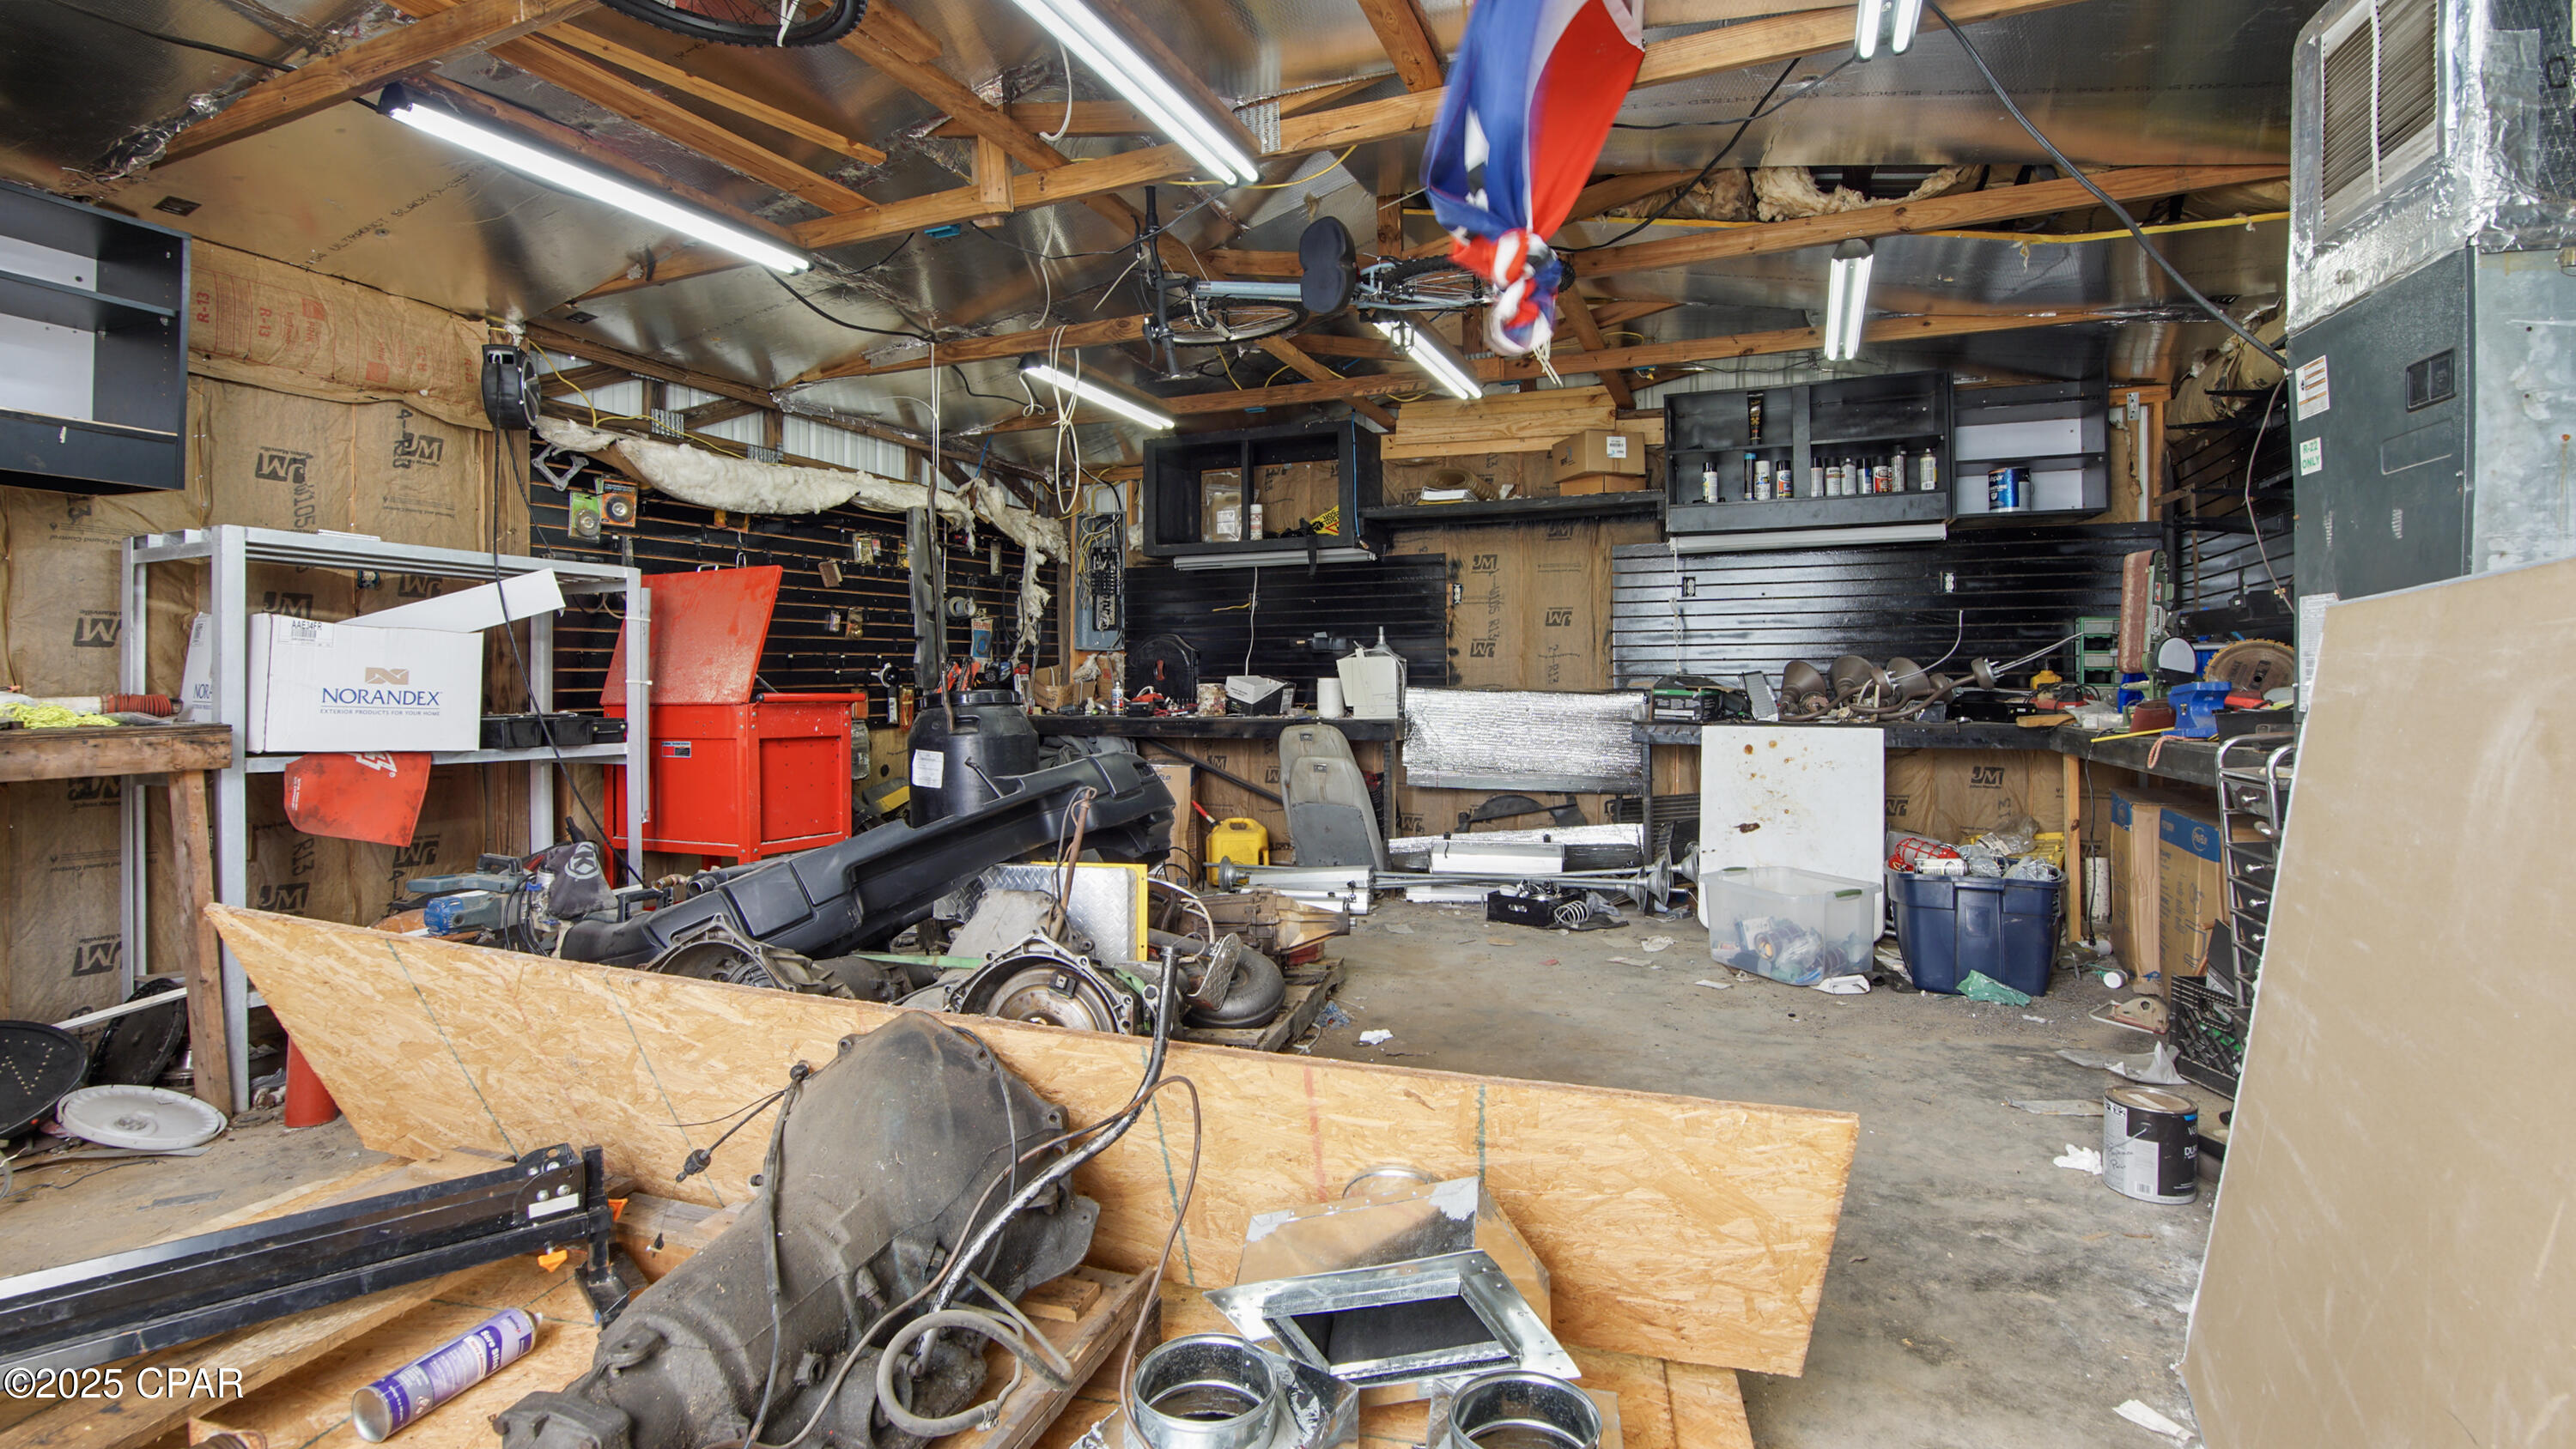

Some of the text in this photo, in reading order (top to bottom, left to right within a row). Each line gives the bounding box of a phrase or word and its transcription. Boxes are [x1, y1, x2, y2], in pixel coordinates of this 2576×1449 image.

[197, 292, 210, 323] R-13
[258, 307, 272, 337] R-13
[2303, 440, 2318, 454] R-22
[2302, 455, 2320, 469] ONLY
[321, 688, 440, 706] NORANDEX
[1971, 767, 2004, 785] JM
[481, 1330, 495, 1349] Sure
